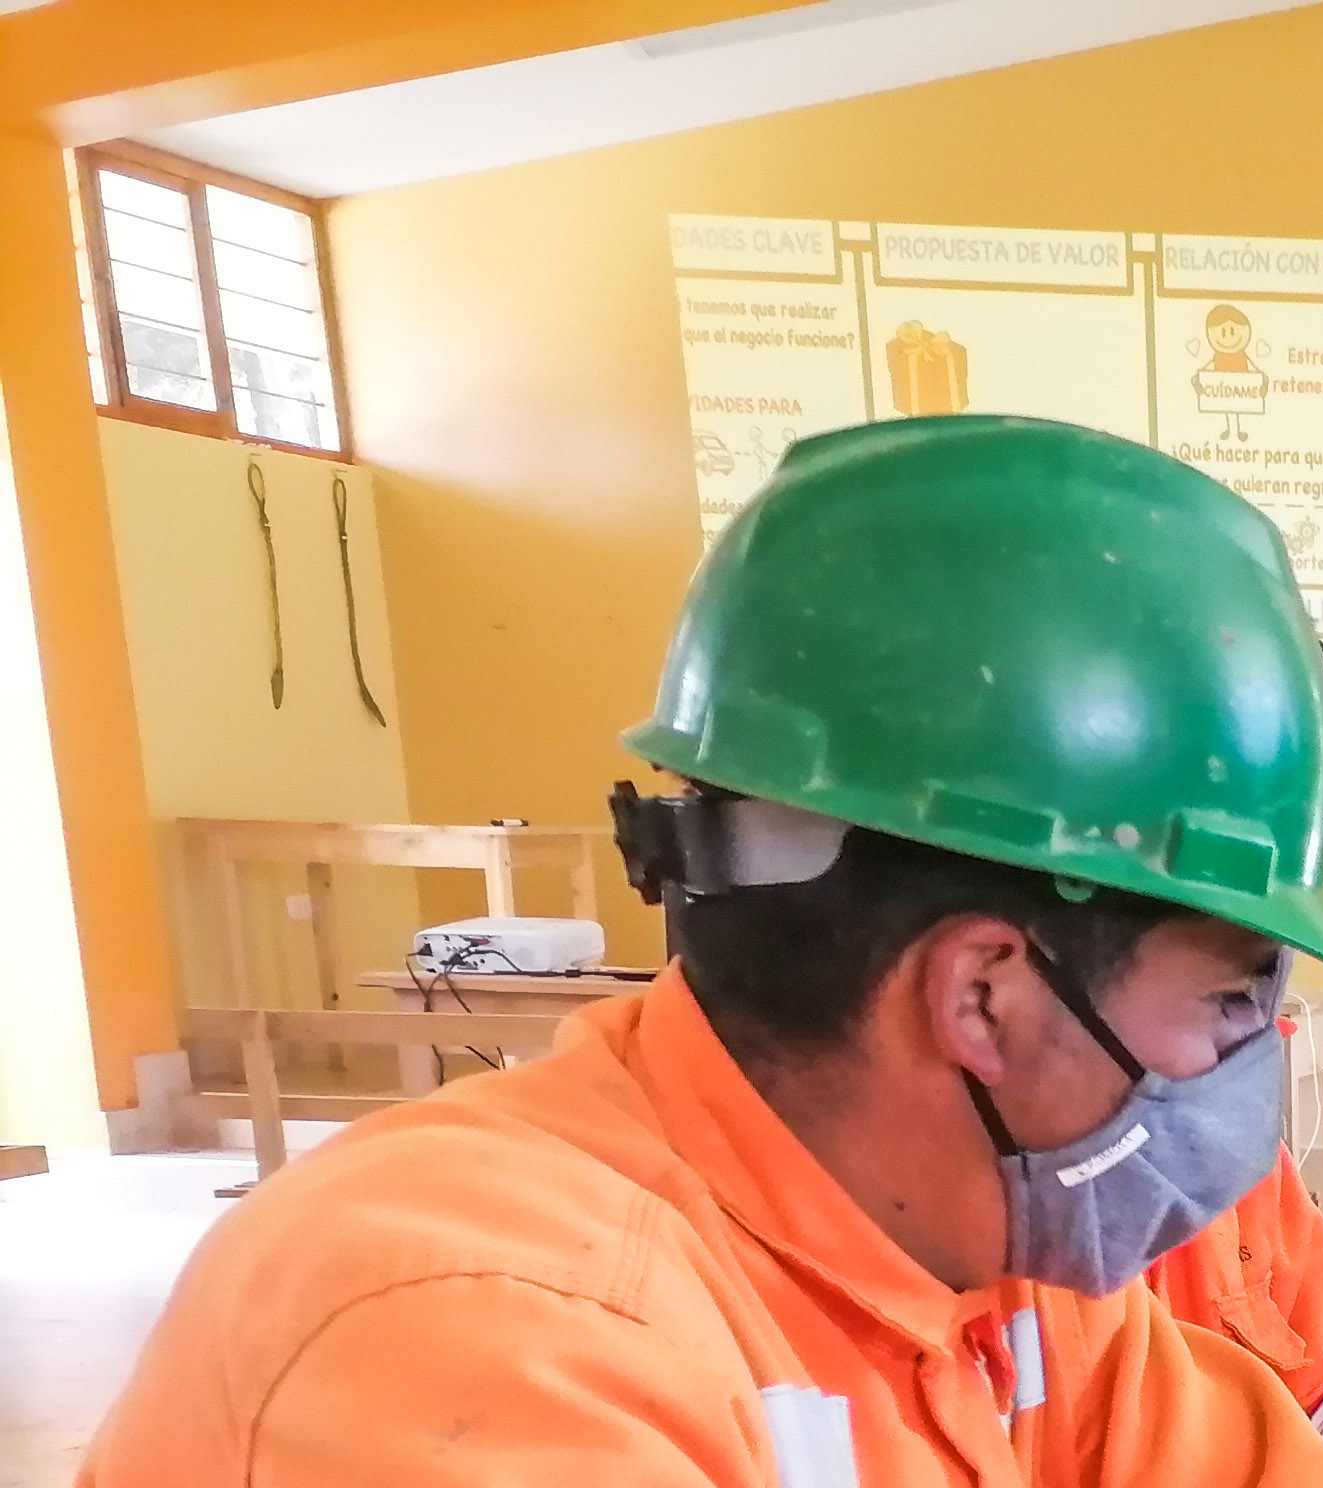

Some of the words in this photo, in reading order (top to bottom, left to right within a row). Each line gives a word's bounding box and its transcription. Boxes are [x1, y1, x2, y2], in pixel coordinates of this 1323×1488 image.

[752, 229, 824, 255] CLAVE
[884, 235, 1009, 263] PROPUESTA
[1016, 242, 1043, 265] DE
[1047, 243, 1120, 268] VALOR
[1165, 243, 1270, 273] RELACIÓN
[1276, 252, 1320, 275] CON
[750, 303, 776, 321] que
[780, 302, 838, 320] realizar
[683, 329, 710, 347] que
[713, 327, 727, 344] el
[729, 330, 784, 350] negocio
[786, 329, 856, 351] funcione?
[758, 397, 803, 417] PARA
[1215, 445, 1260, 463] hacer
[1264, 449, 1301, 469] para
[1232, 476, 1291, 496] quieran
